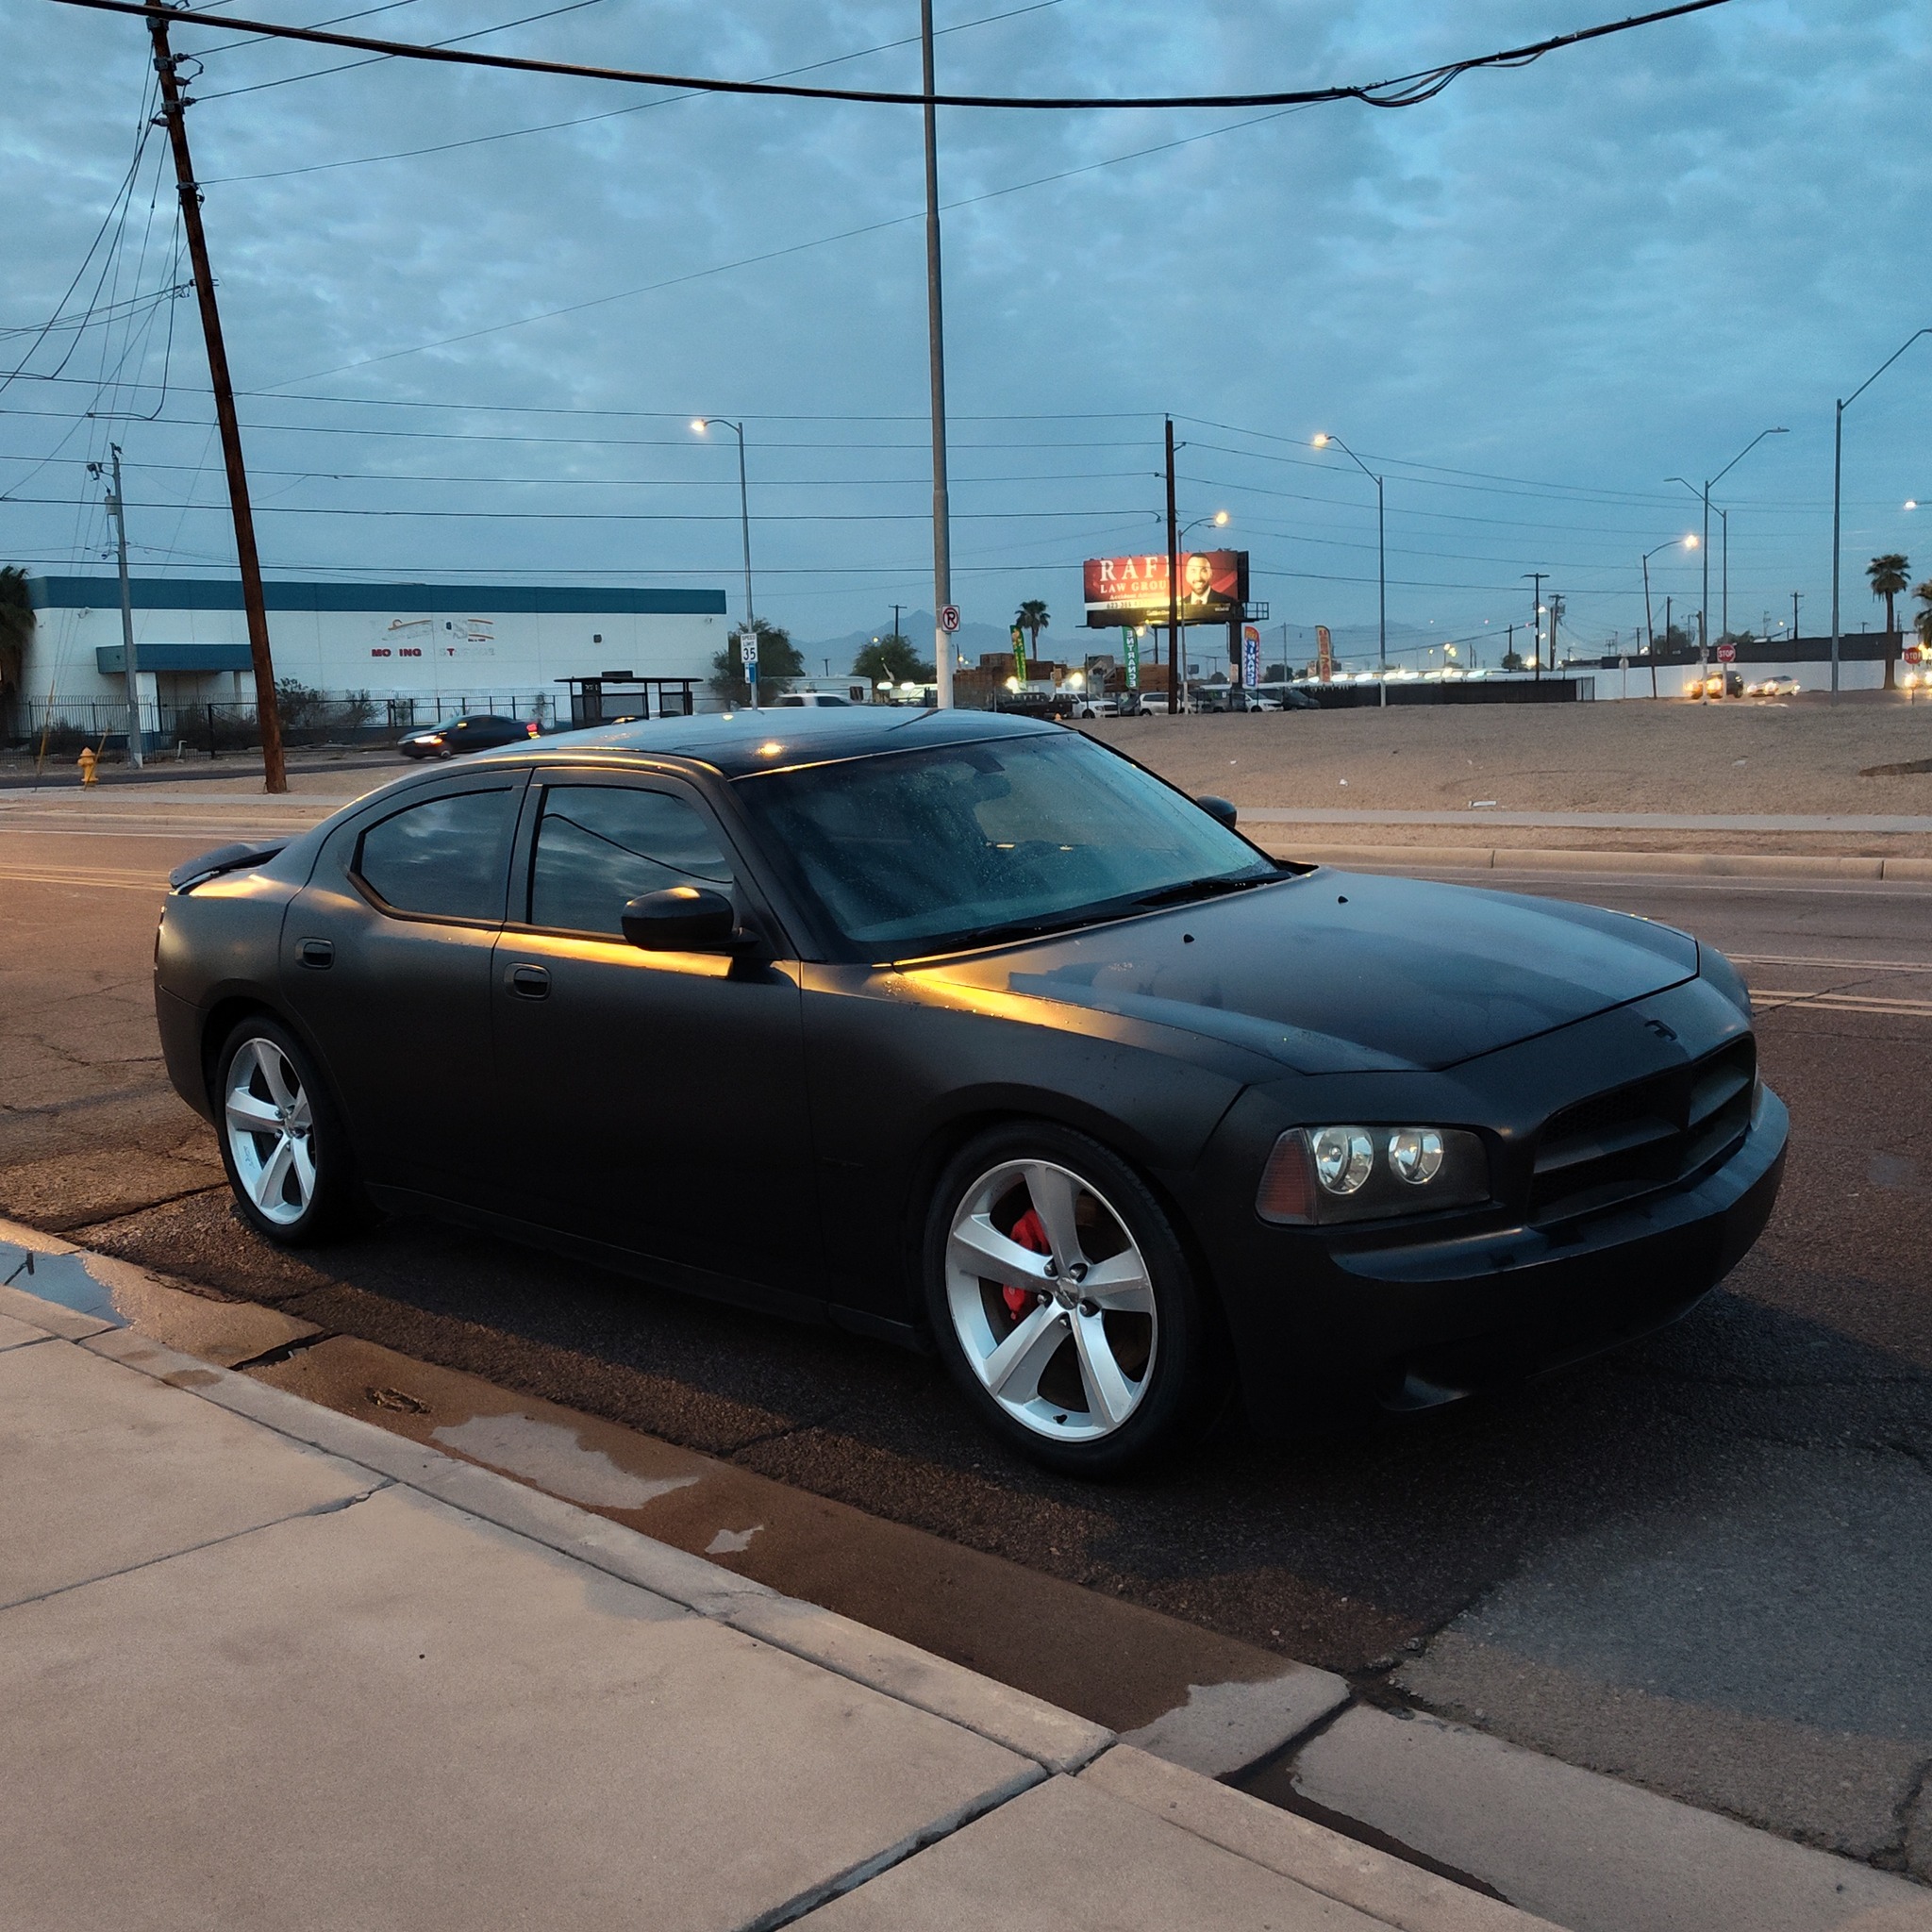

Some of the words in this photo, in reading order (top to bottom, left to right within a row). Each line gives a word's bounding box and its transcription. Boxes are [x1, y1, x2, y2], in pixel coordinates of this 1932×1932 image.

[1100, 583, 1126, 593] LAW
[1131, 579, 1167, 591] GROU
[743, 647, 756, 660] 35
[1718, 650, 1734, 658] STOP
